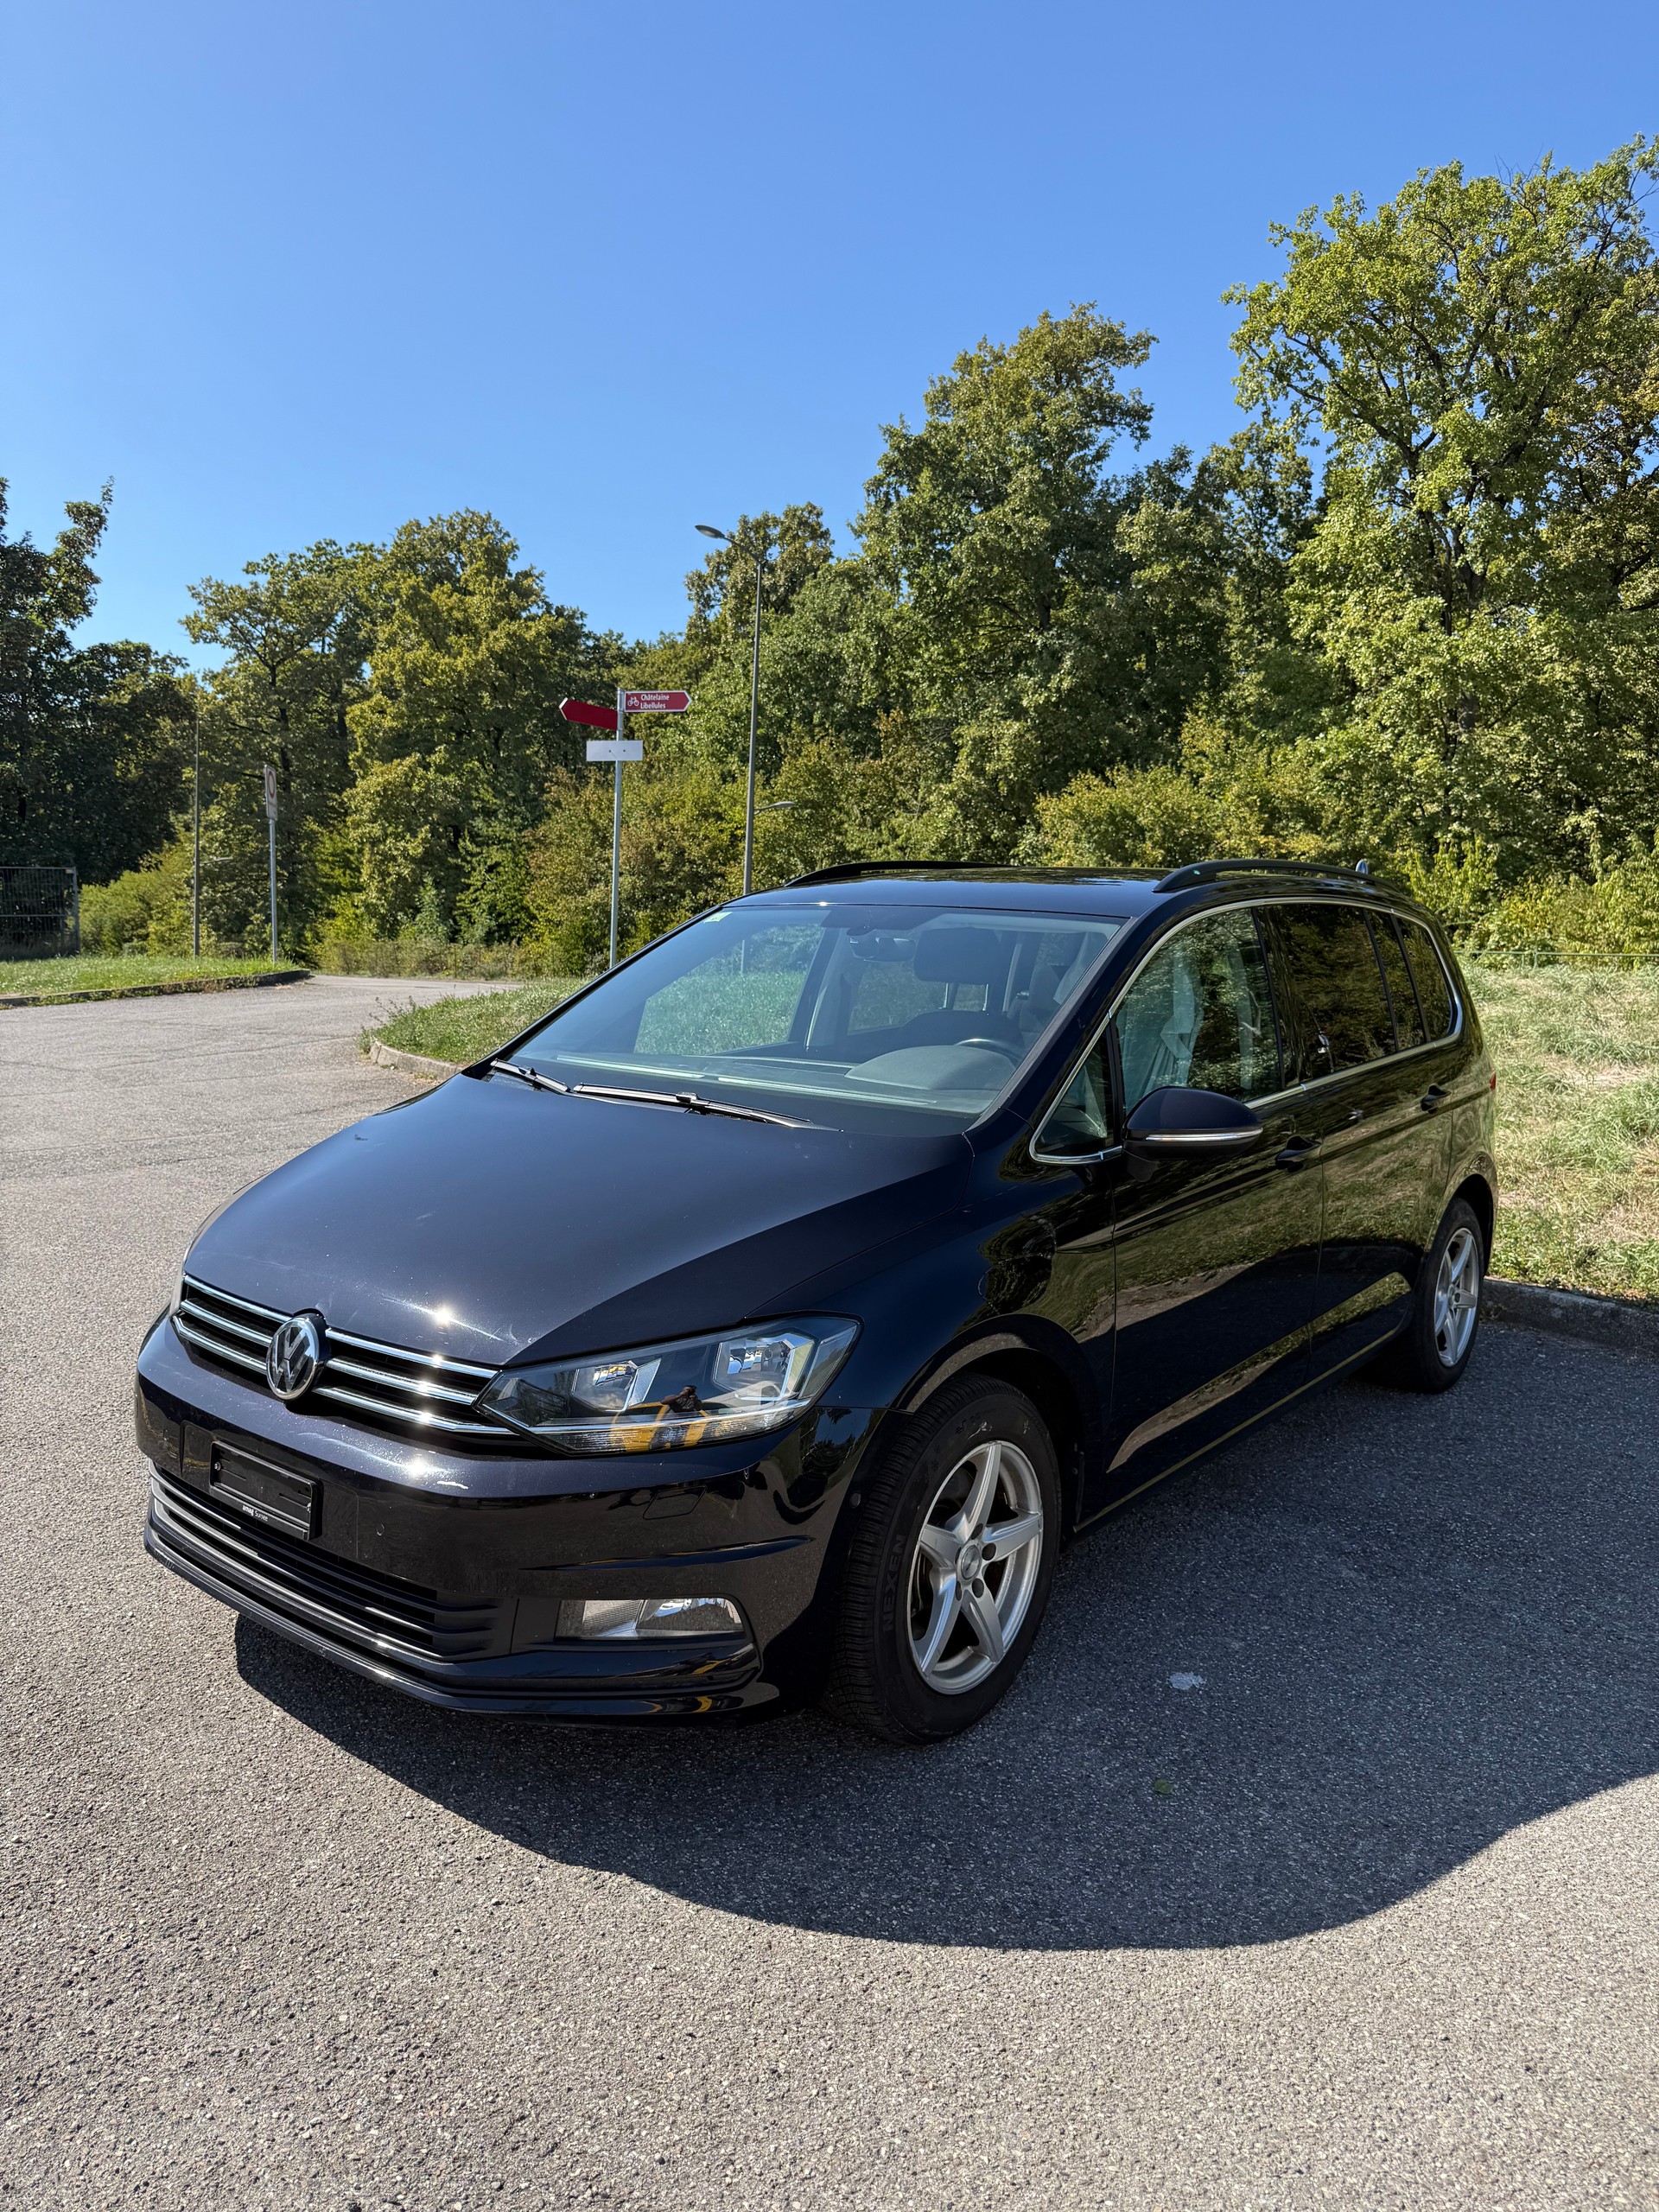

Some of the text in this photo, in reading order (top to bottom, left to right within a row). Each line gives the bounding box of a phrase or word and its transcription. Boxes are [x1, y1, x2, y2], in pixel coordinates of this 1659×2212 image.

[269, 1320, 316, 1397] VW
[242, 1505, 254, 1516] amag
[882, 1534, 906, 1632] NEXEN
